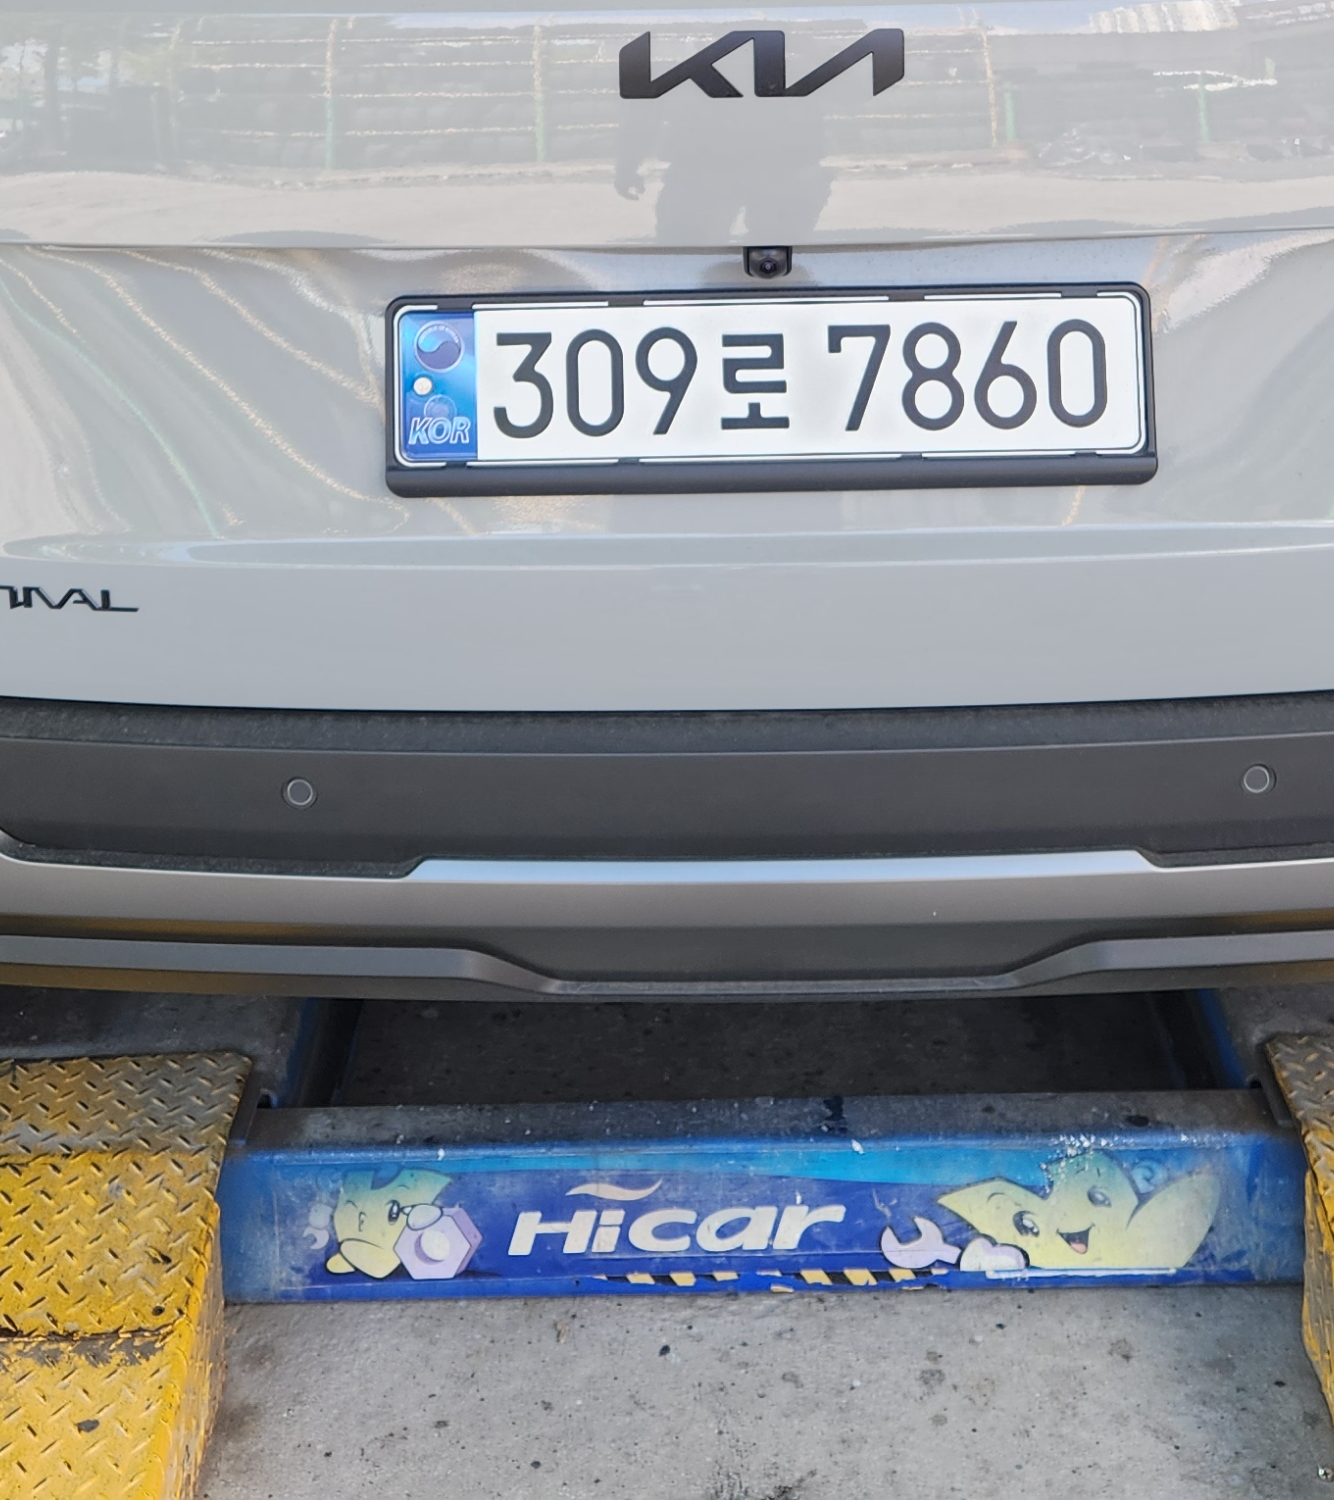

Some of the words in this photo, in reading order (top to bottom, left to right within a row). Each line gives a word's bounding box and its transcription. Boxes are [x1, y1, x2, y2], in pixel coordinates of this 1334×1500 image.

[618, 28, 906, 100] KIA
[492, 325, 791, 439] 309로
[827, 317, 1108, 432] 7860
[408, 416, 471, 445] KOR
